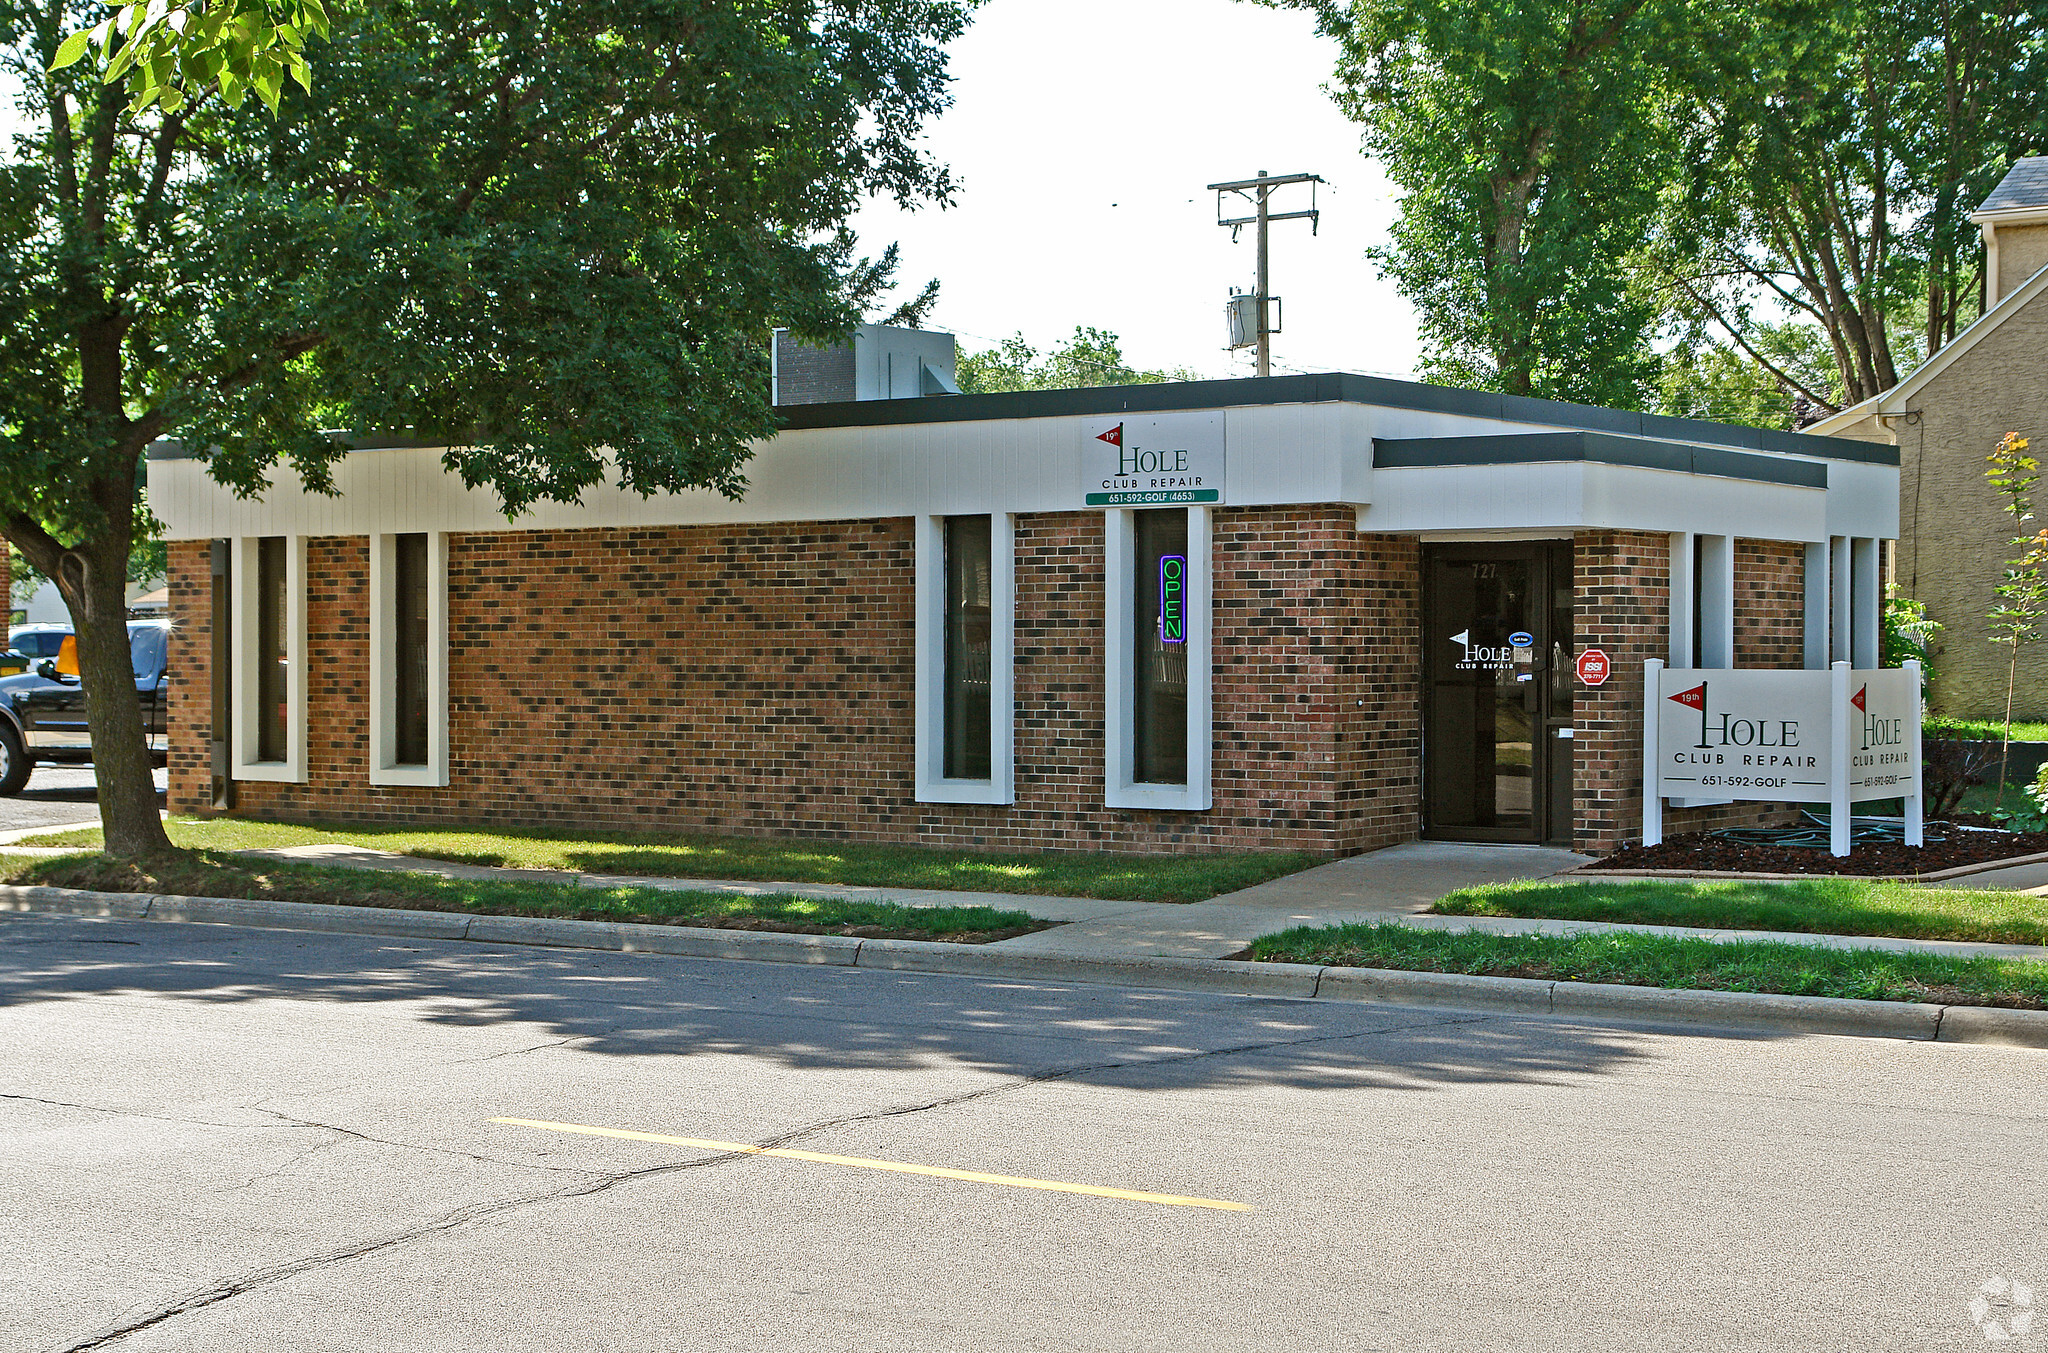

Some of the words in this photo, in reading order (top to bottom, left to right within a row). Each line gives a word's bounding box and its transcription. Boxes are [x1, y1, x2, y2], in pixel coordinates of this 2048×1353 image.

[1105, 432, 1118, 441] 19th
[1118, 446, 1189, 475] HOLE
[1102, 479, 1138, 489] CLUB
[1151, 477, 1202, 488] REPAIR
[1108, 492, 1167, 503] 651-592-GOLF
[1169, 492, 1195, 501] (4653)
[1472, 563, 1496, 579] 727
[1163, 560, 1181, 637] OPEN
[1464, 644, 1511, 661] HOLE
[1584, 662, 1603, 671] ISSI
[1681, 693, 1700, 702] 19th
[1701, 713, 1800, 747] HOLE
[1863, 713, 1902, 746] HOLE
[1674, 752, 1725, 764] CLUB
[1743, 754, 1816, 768] REPAIR
[1853, 755, 1874, 767] CLUB
[1880, 752, 1909, 764] REPAIR
[1701, 776, 1787, 788] 651-592-GOLF
[1864, 775, 1898, 787] 651-592-GOLF
